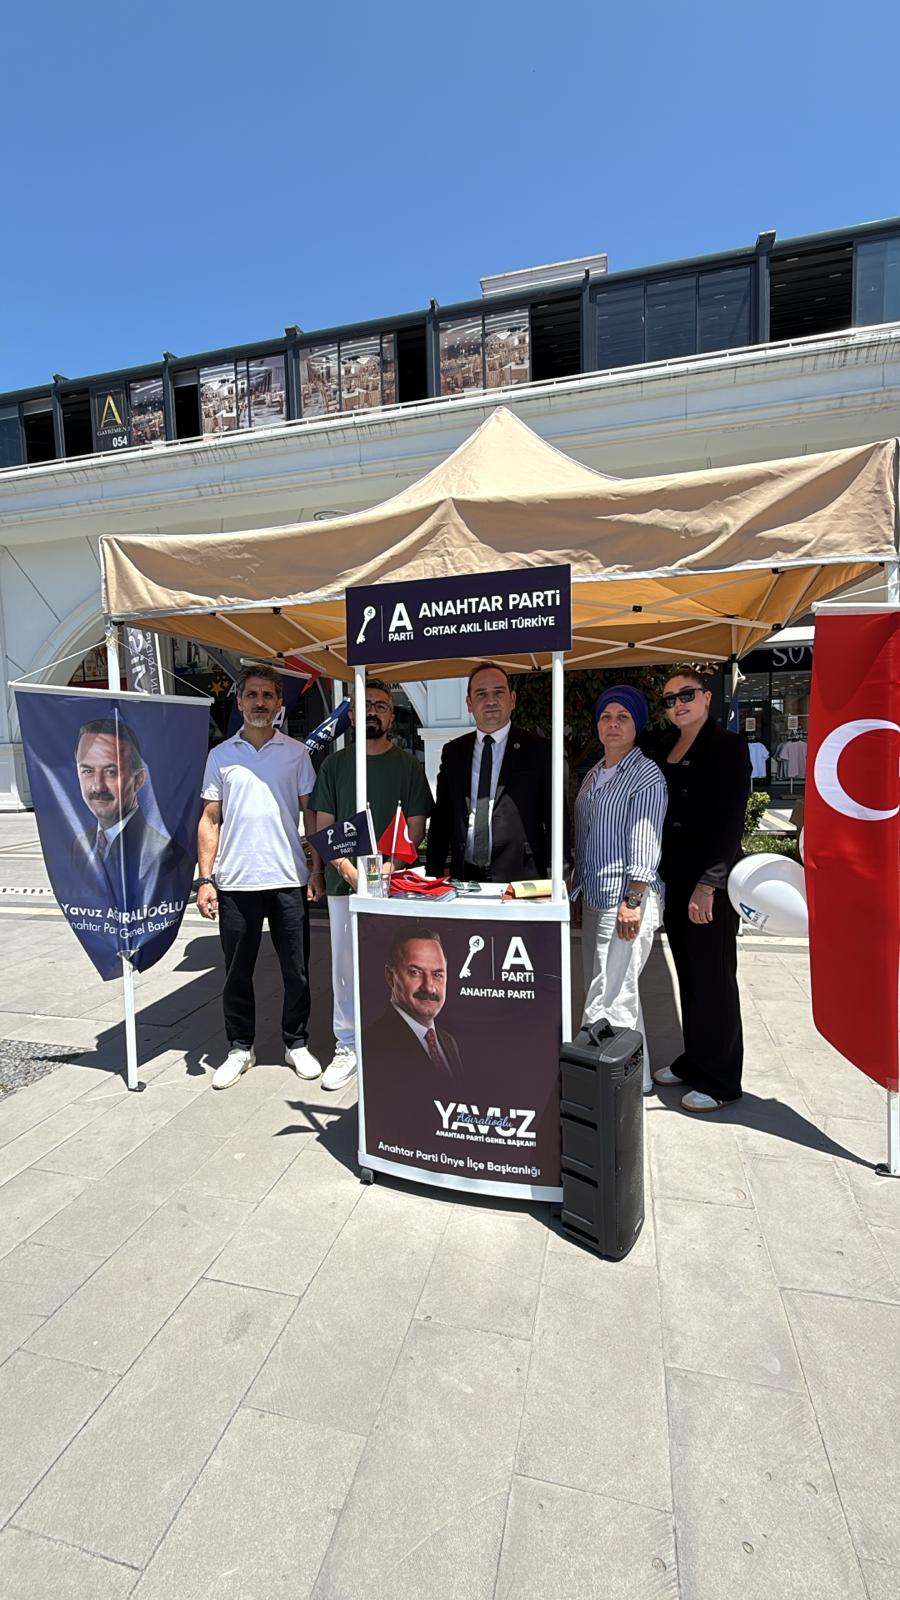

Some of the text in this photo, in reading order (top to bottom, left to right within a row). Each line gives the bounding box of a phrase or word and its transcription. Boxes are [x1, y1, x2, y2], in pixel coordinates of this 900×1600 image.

[112, 435, 128, 447] 054
[418, 595, 503, 618] ANAHTAR
[388, 602, 413, 632] A
[423, 614, 555, 636] ORTAK AKIL İLERİ TÜRKİYE
[343, 821, 356, 833] A
[61, 903, 103, 918] Yavuz
[739, 902, 756, 920] A
[71, 918, 101, 932] nahtar
[501, 936, 534, 971] A
[460, 986, 505, 998] ANAHTAR
[434, 1100, 536, 1138] YAVUZ
[435, 1129, 465, 1140] ANAHTAR
[485, 1137, 507, 1145] GENEL
[507, 1139, 537, 1148] BAŞKANI
[378, 1141, 541, 1178] Anahtar Parti Ünye İlçe Başkanlığı
